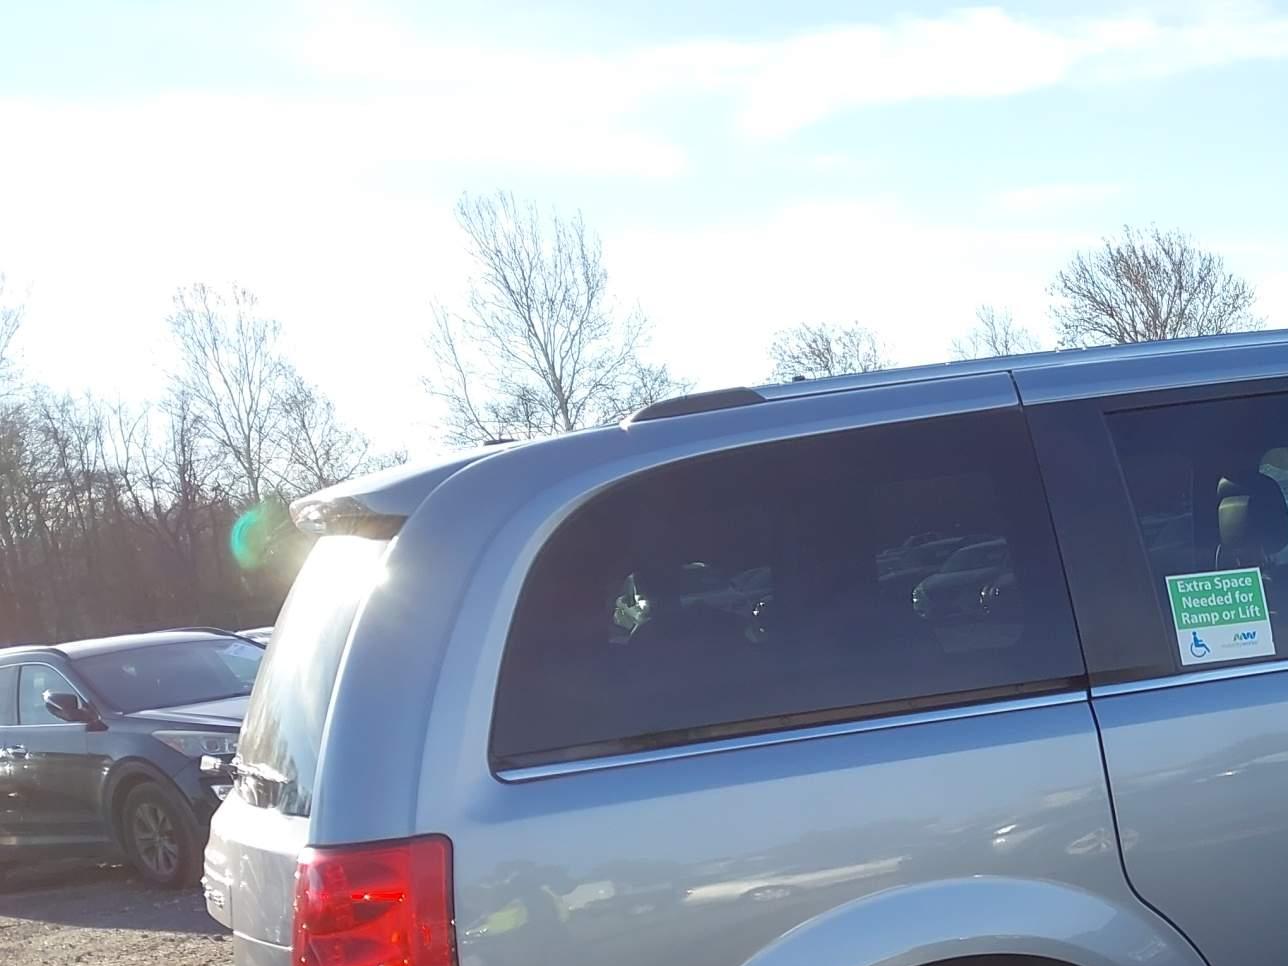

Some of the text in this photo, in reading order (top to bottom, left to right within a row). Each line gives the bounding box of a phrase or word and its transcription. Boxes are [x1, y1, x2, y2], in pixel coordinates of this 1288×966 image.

[1177, 577, 1252, 593] Extra Space
[1182, 591, 1254, 609] Needed for
[1181, 605, 1261, 625] Ramp or Lift
